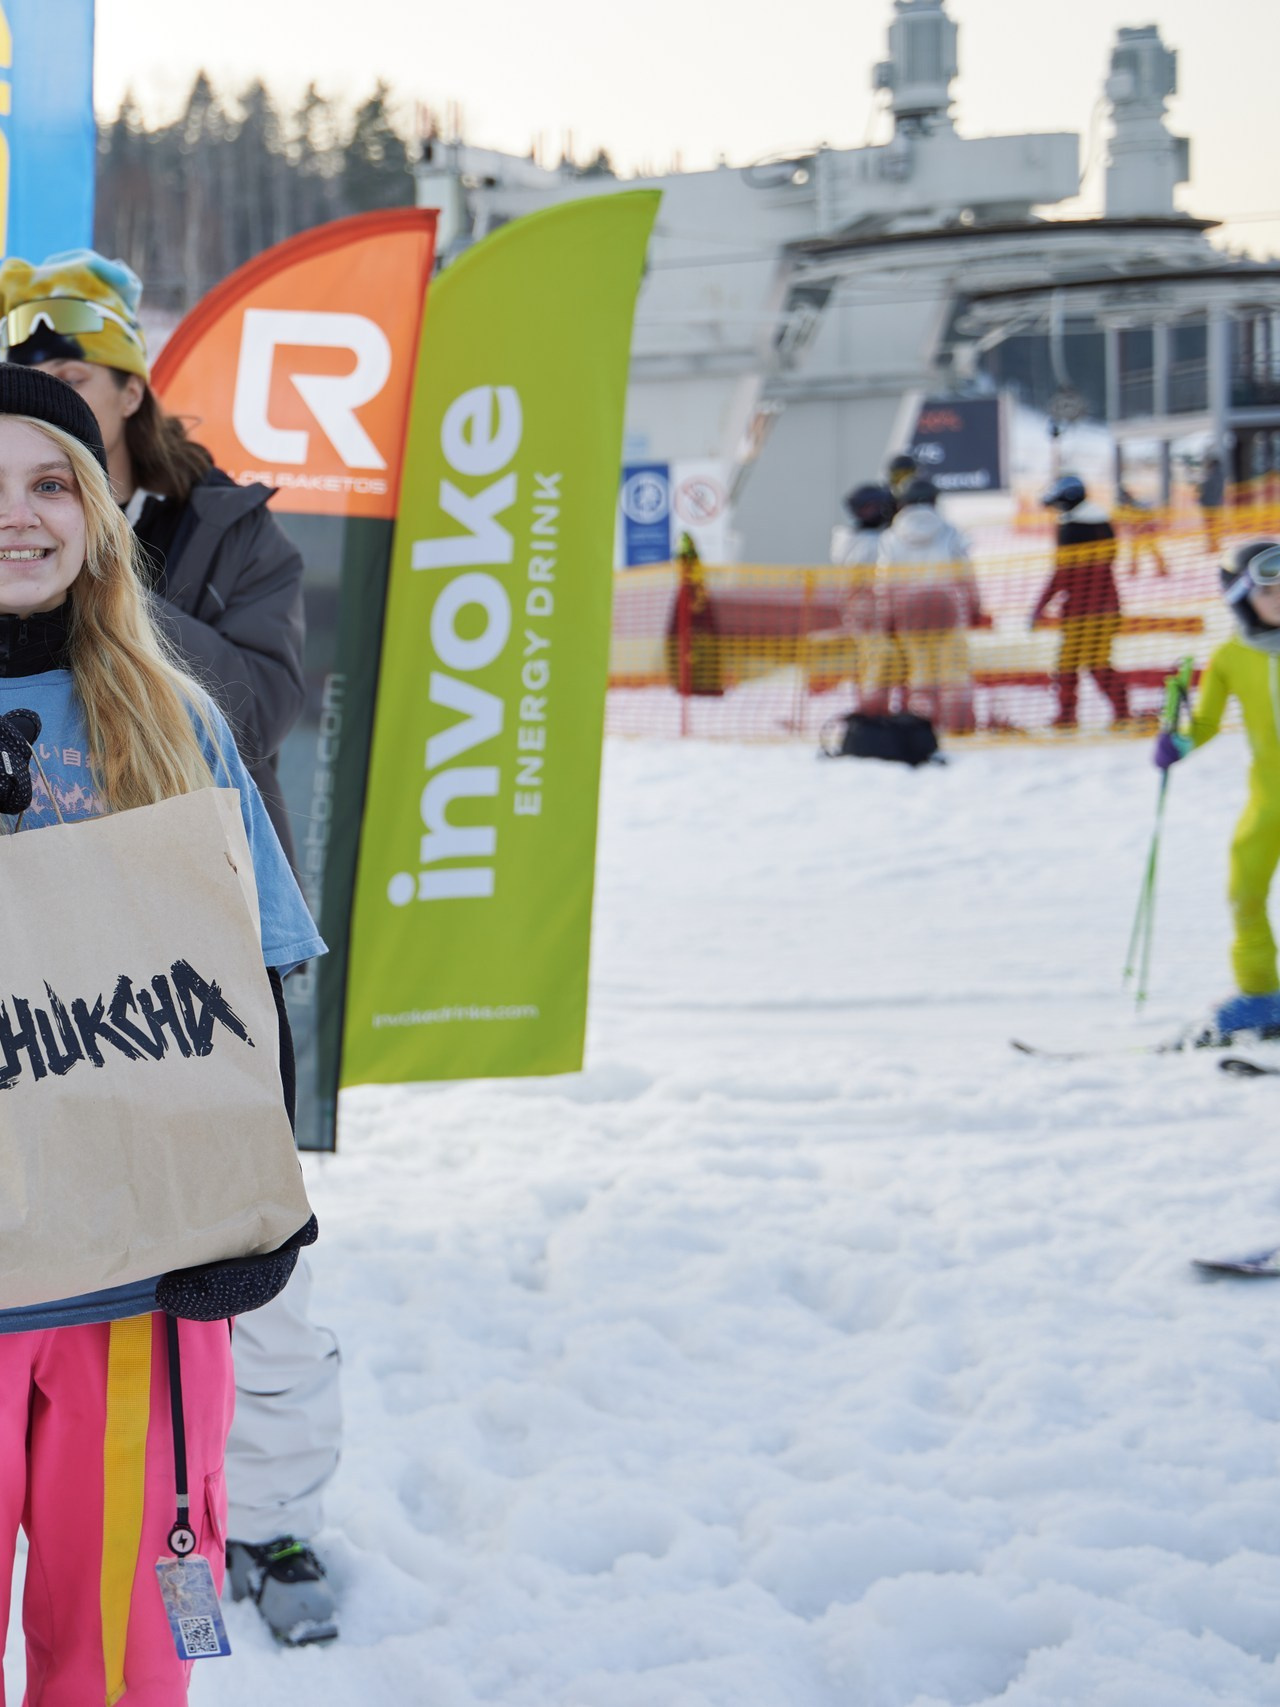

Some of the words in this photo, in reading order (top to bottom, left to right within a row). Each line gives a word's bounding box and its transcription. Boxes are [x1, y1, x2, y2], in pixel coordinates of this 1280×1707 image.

[525, 472, 563, 617] DRINK
[387, 384, 524, 907] invoke
[513, 630, 551, 817] ENERGY
